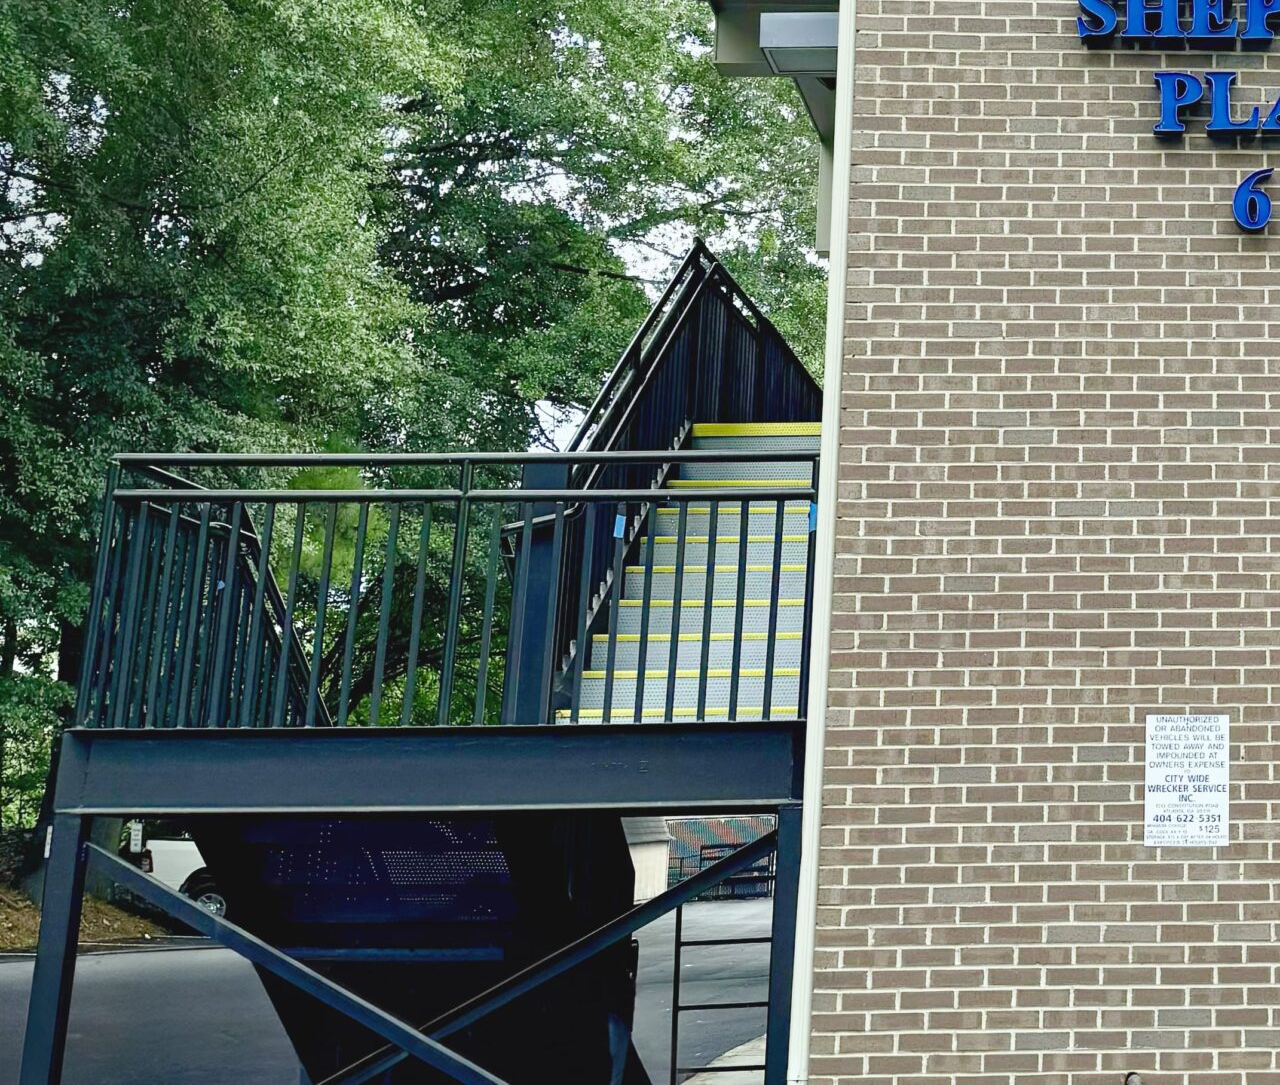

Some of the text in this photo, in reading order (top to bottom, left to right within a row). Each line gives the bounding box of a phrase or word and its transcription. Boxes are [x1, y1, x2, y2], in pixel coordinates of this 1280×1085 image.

[1156, 716, 1220, 724] UNAUTHORIZED
[1149, 734, 1225, 742] VEHICLES WILL BE
[1156, 752, 1218, 760] IMPOUNDED AT
[1149, 761, 1226, 769] OWNERS EXPENSE
[1164, 775, 1210, 783] CITY WIDE
[1147, 784, 1227, 793] WRECKER SERVICE
